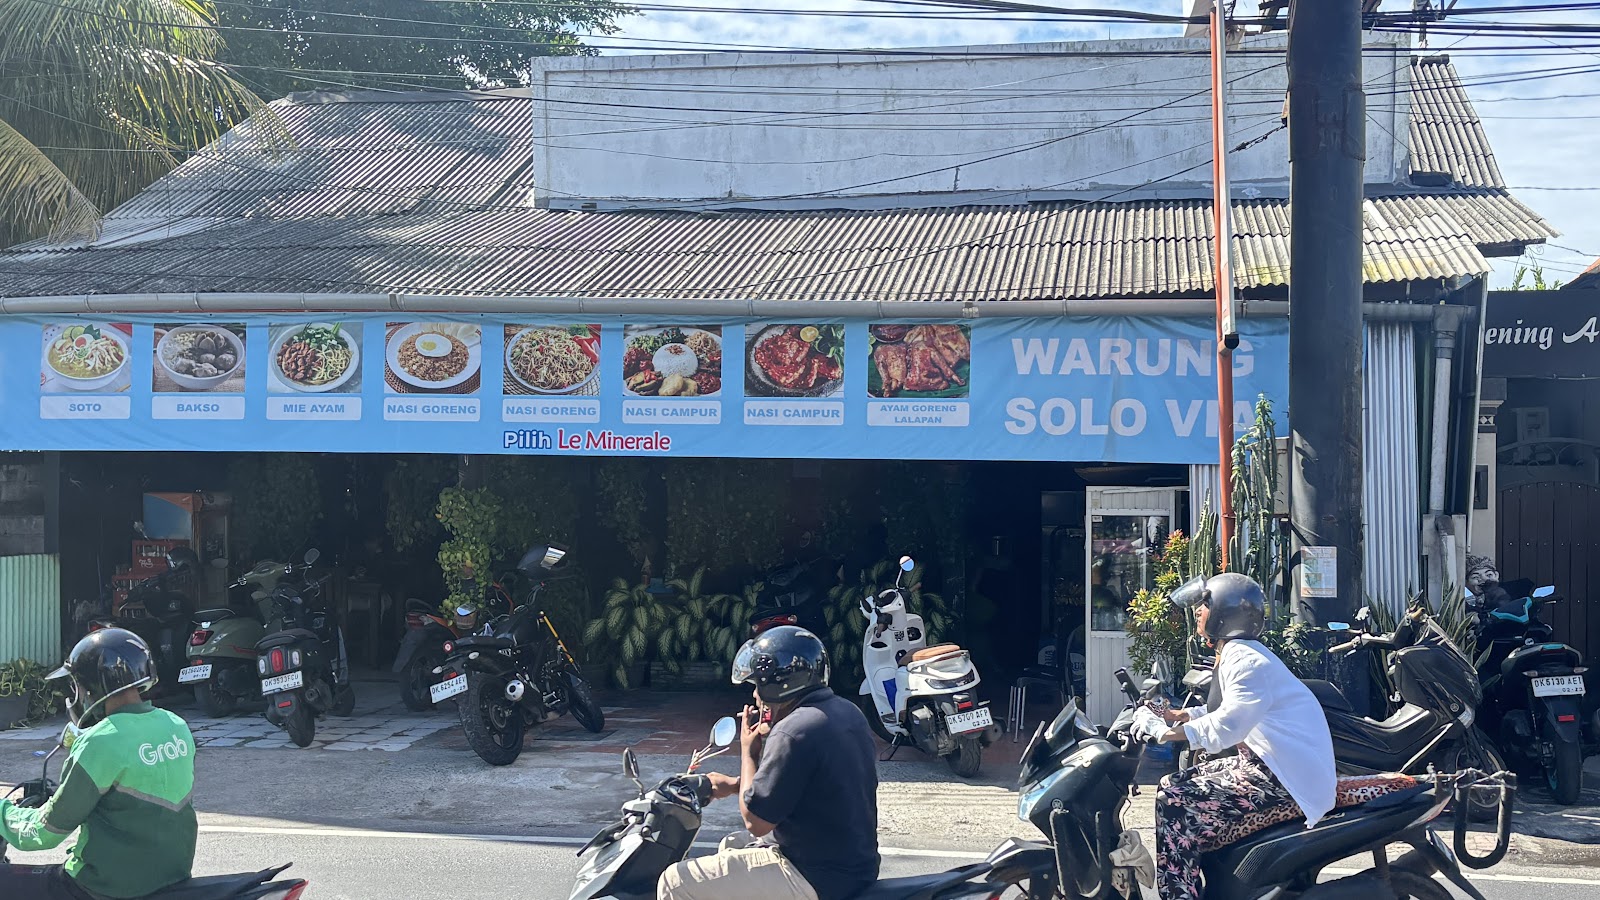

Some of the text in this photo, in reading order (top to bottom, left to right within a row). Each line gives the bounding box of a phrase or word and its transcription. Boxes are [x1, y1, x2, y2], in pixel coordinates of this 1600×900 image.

[1011, 338, 1255, 377] WARUNG
[68, 403, 102, 412] SOTO
[176, 403, 220, 412] BAKSO
[283, 404, 345, 413] MIE AYAM
[387, 404, 477, 415] NASI GORENG
[505, 406, 597, 416] NASI GORENG
[625, 407, 718, 417] NASI CAMPUR
[880, 404, 957, 412] AYAM GORENG
[747, 408, 840, 419] NASI CAMPUR
[1004, 397, 1260, 438] SOLO VIA
[894, 416, 942, 424] LALAPAN
[503, 428, 671, 451] Pilih Le Minerale
[138, 734, 188, 766] Grab
